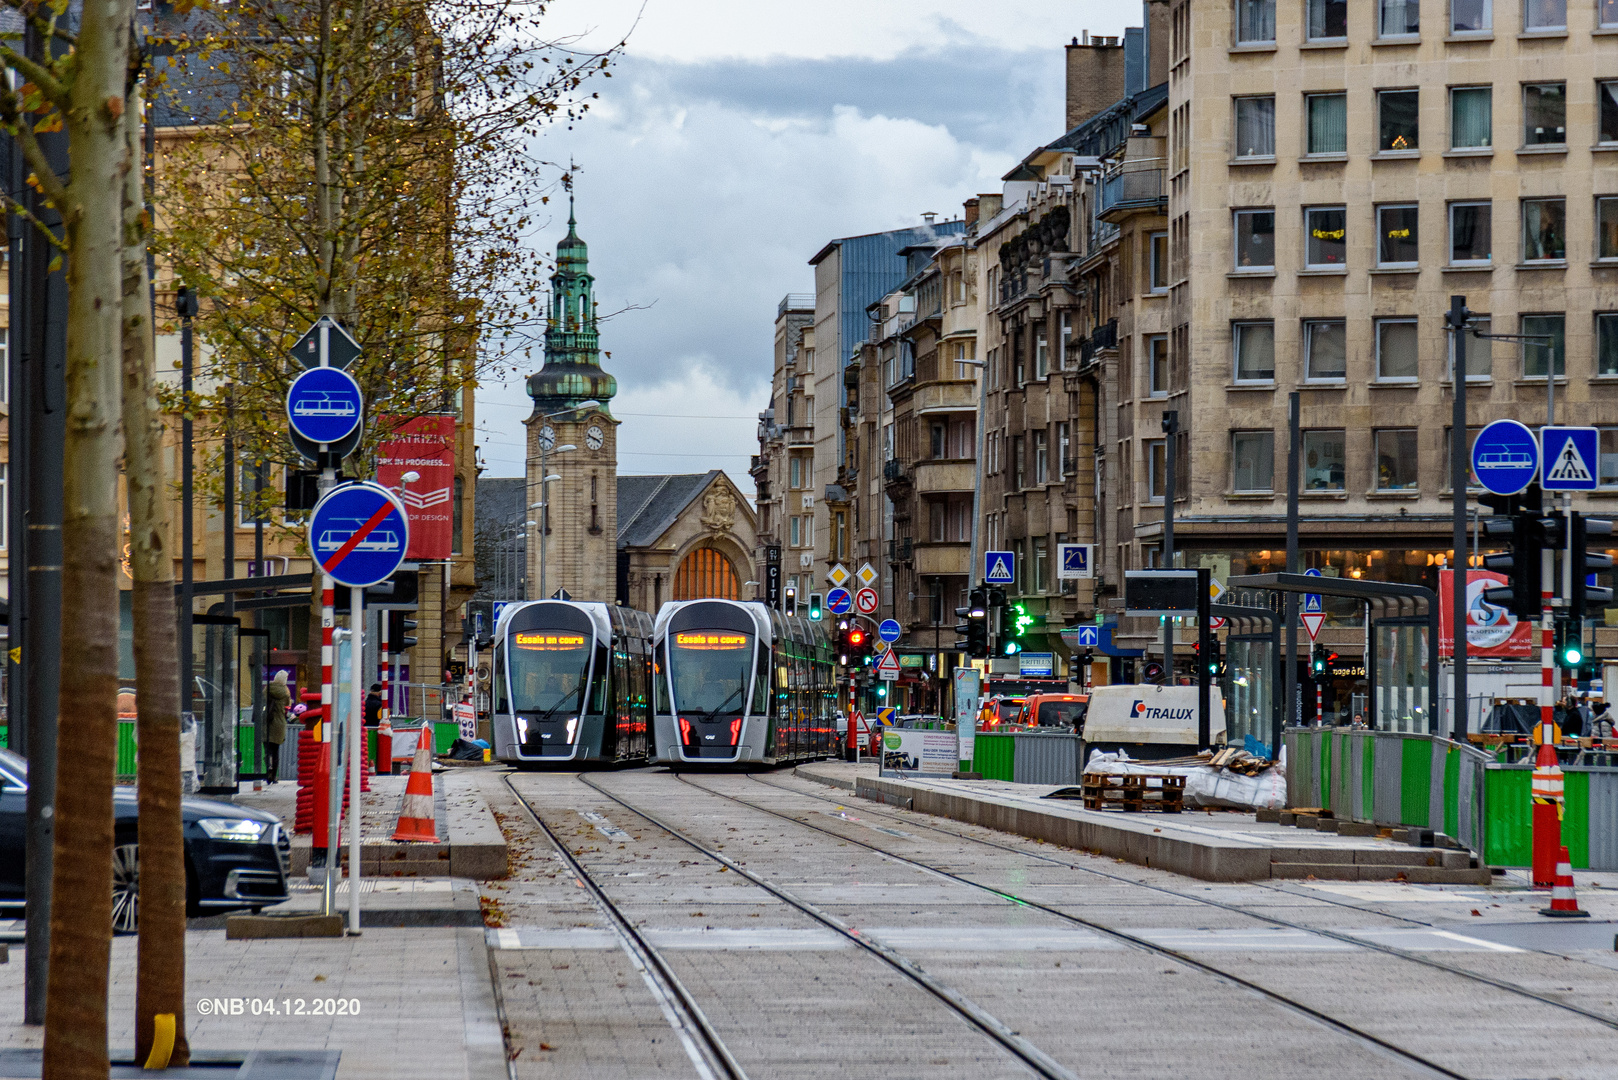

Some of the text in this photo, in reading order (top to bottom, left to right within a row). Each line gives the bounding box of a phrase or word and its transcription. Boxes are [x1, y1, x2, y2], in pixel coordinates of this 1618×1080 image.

[394, 458, 404, 466] IN
[769, 567, 778, 610] CITY
[516, 633, 584, 644] Essais en cours
[677, 633, 746, 644] Essais en cours
[450, 665, 463, 675] 51
[1146, 707, 1195, 720] TRALUX
